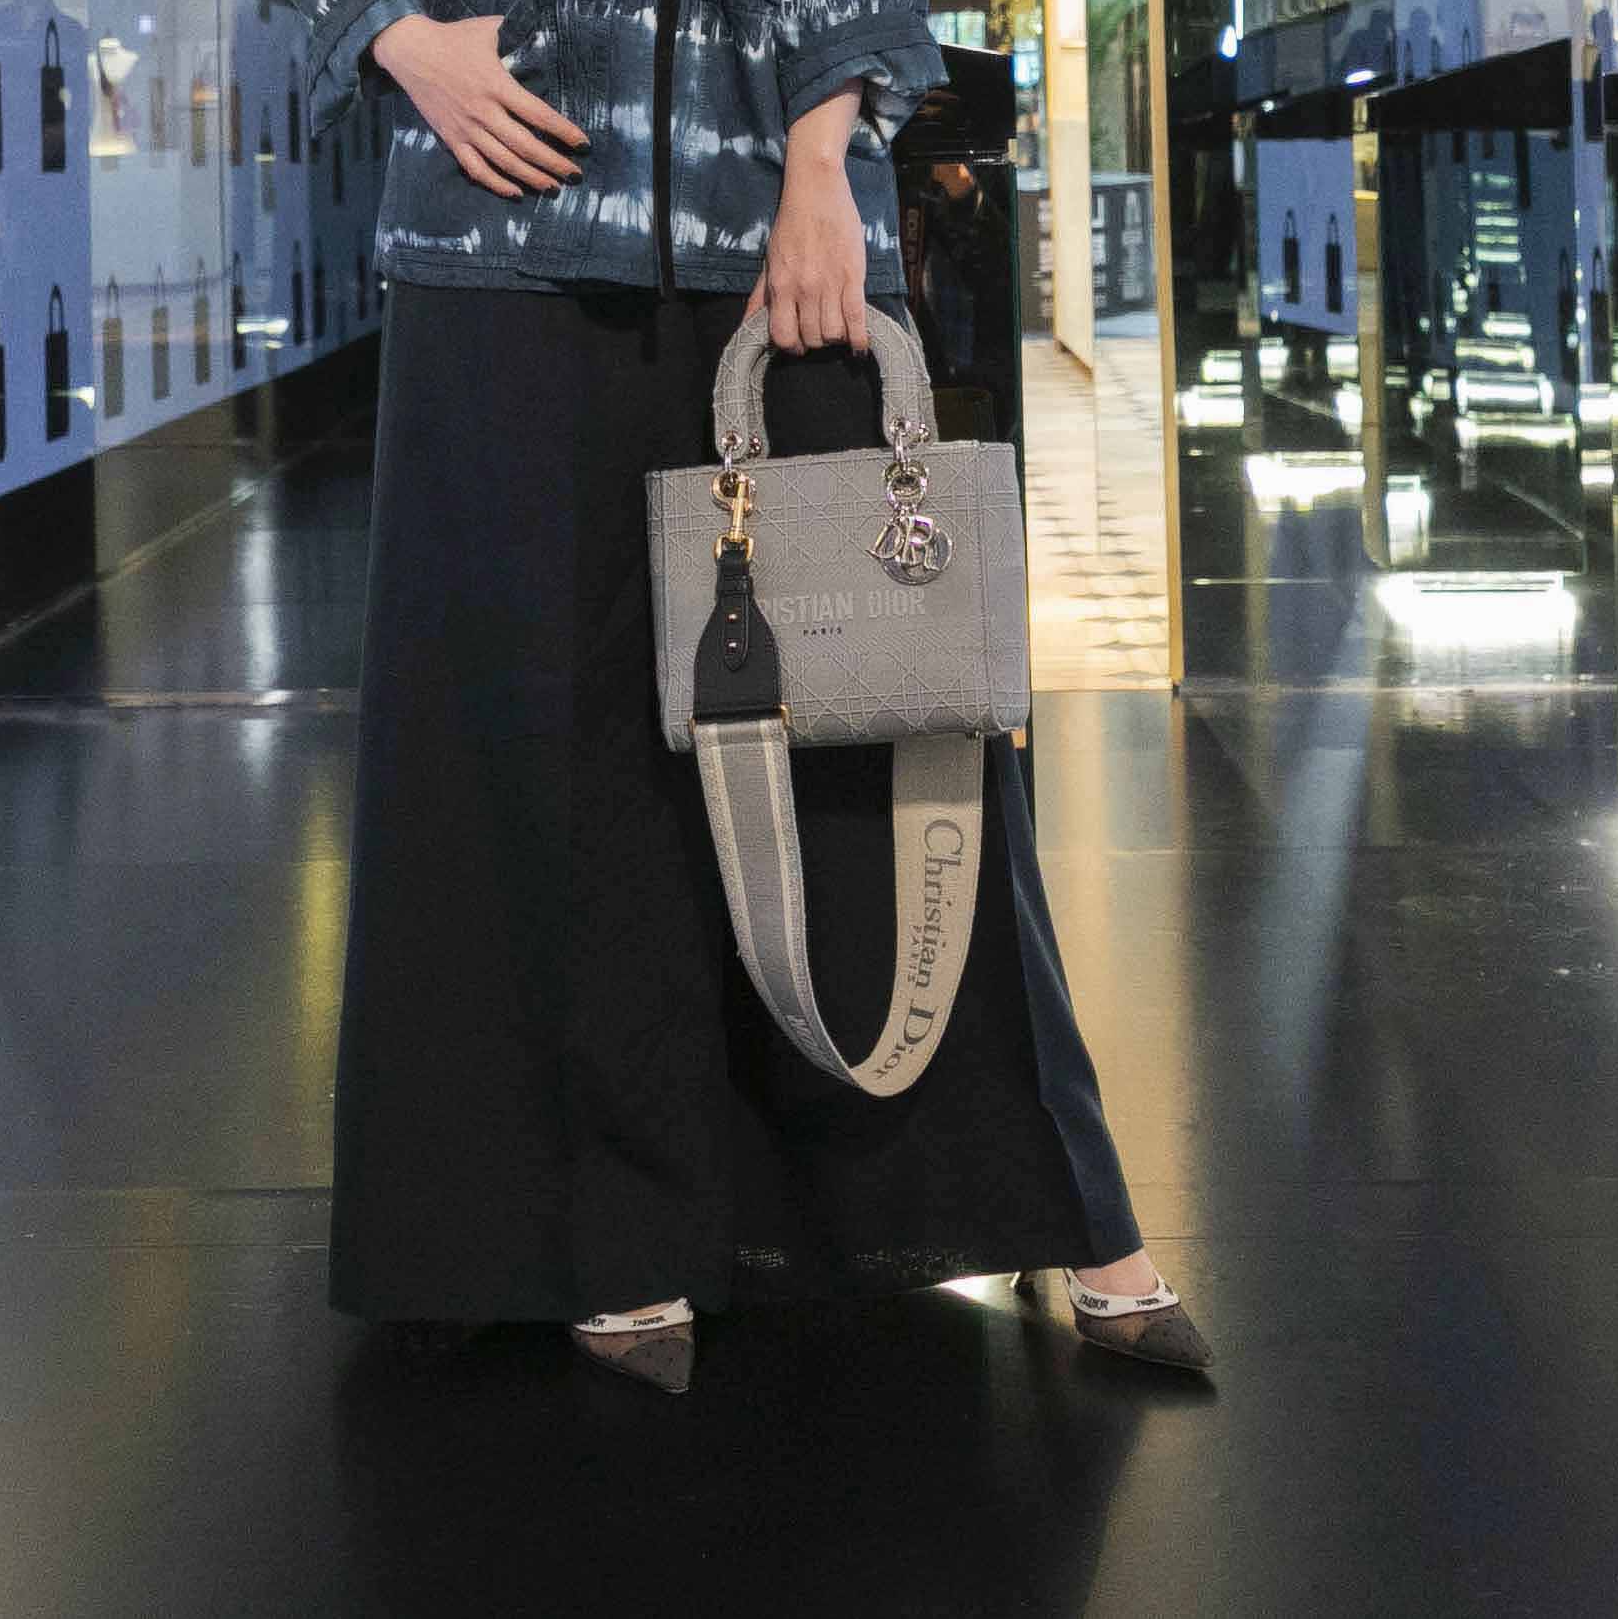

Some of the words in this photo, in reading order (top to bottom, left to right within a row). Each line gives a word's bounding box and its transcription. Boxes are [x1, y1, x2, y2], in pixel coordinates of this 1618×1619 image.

[803, 626, 842, 636] PARIS
[868, 588, 926, 620] DIOR
[914, 818, 965, 989] Christian
[907, 924, 924, 983] PARIS
[874, 996, 936, 1079] Dior
